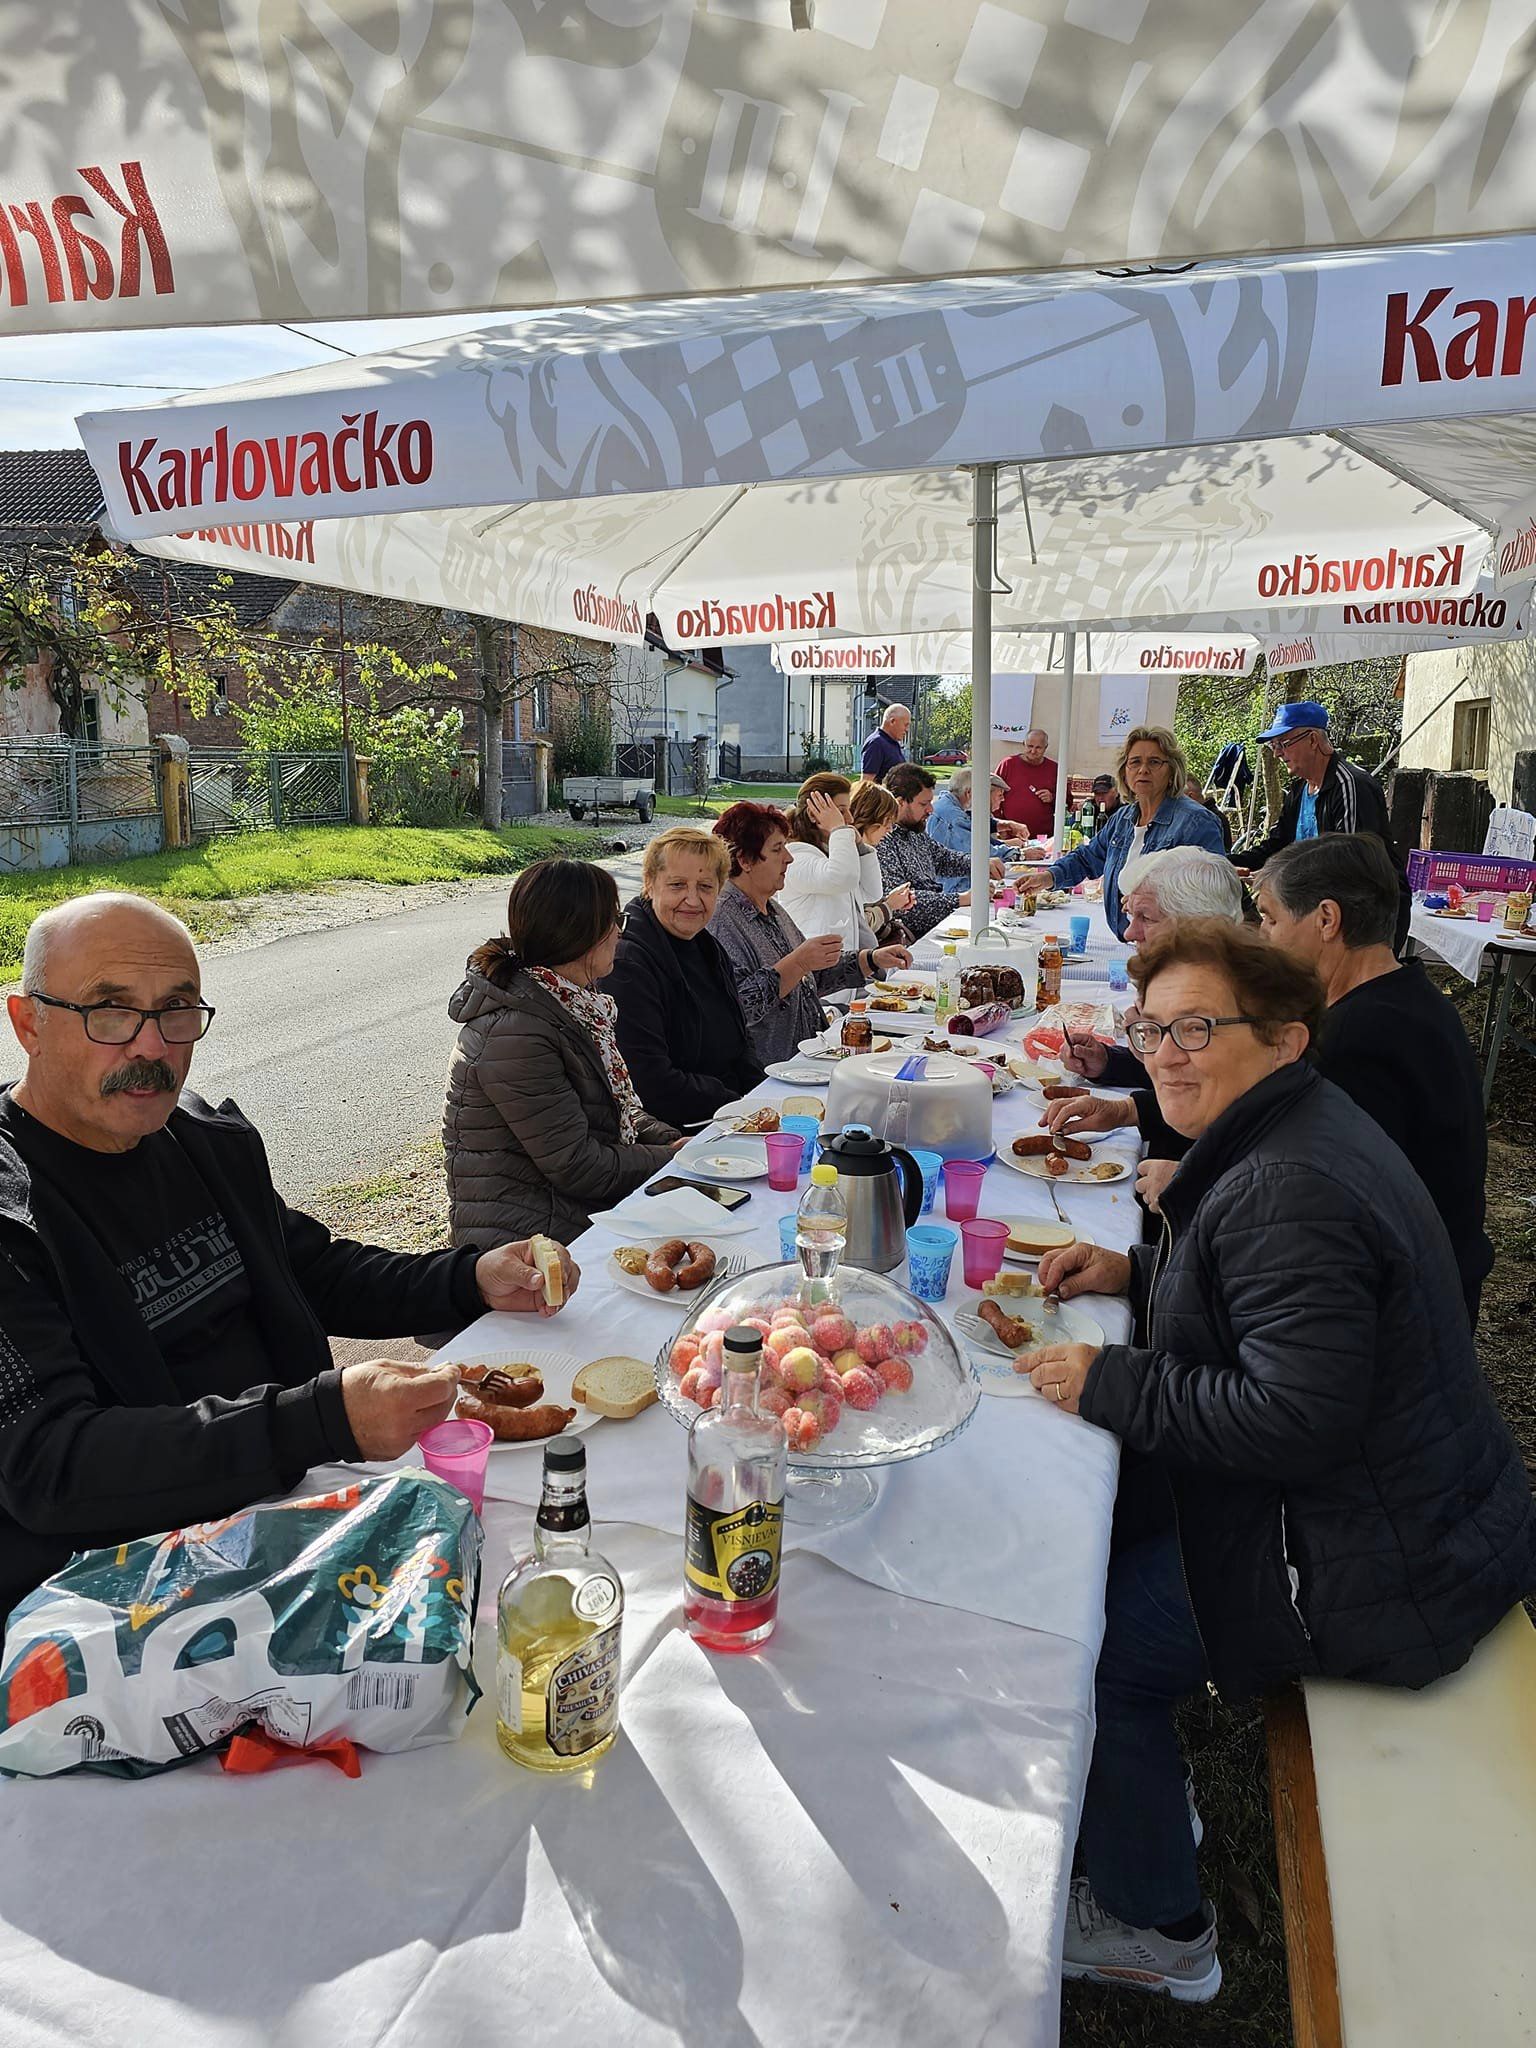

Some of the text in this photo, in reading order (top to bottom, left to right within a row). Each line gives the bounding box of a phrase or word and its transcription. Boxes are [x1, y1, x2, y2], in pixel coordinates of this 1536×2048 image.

[117, 410, 433, 516] Karlovačko
[165, 1226, 195, 1252] BEST
[557, 1659, 603, 1688] CHIVAS
[559, 1696, 596, 1713] PREMIUM
